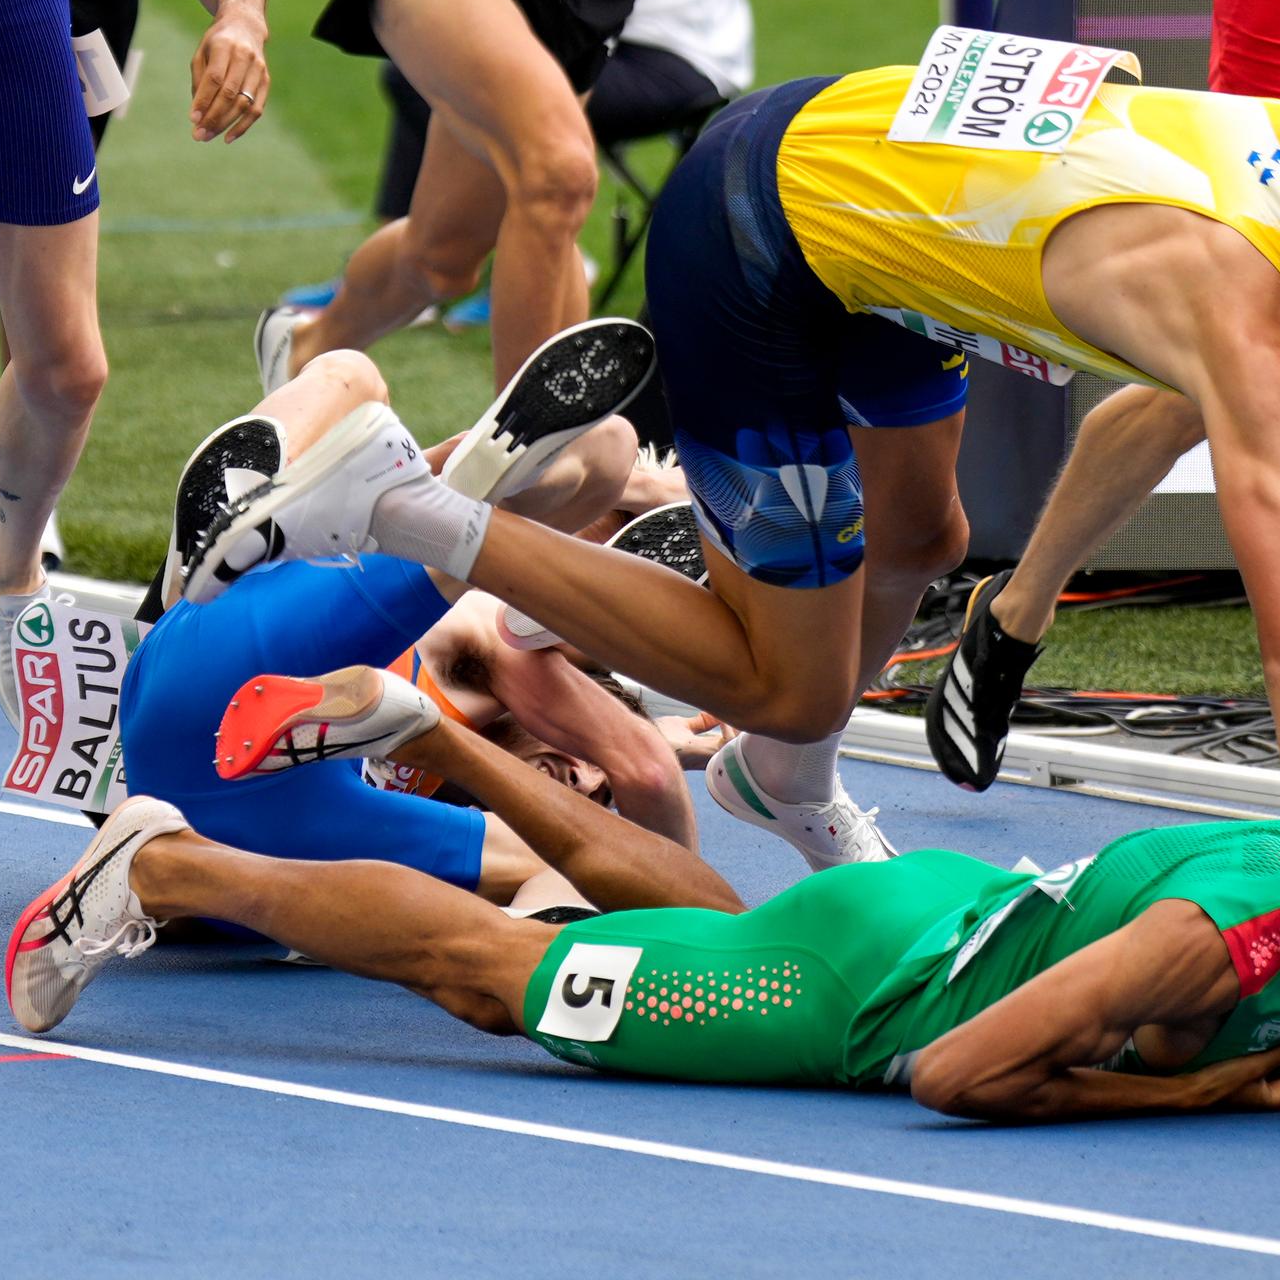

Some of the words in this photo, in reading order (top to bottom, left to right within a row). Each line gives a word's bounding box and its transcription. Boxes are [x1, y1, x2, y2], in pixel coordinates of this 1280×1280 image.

[910, 63, 949, 117] 2024
[958, 37, 1042, 139] STRÖM
[12, 653, 58, 788] SPAR
[53, 618, 119, 800] BALTUS
[562, 973, 616, 1009] 5
